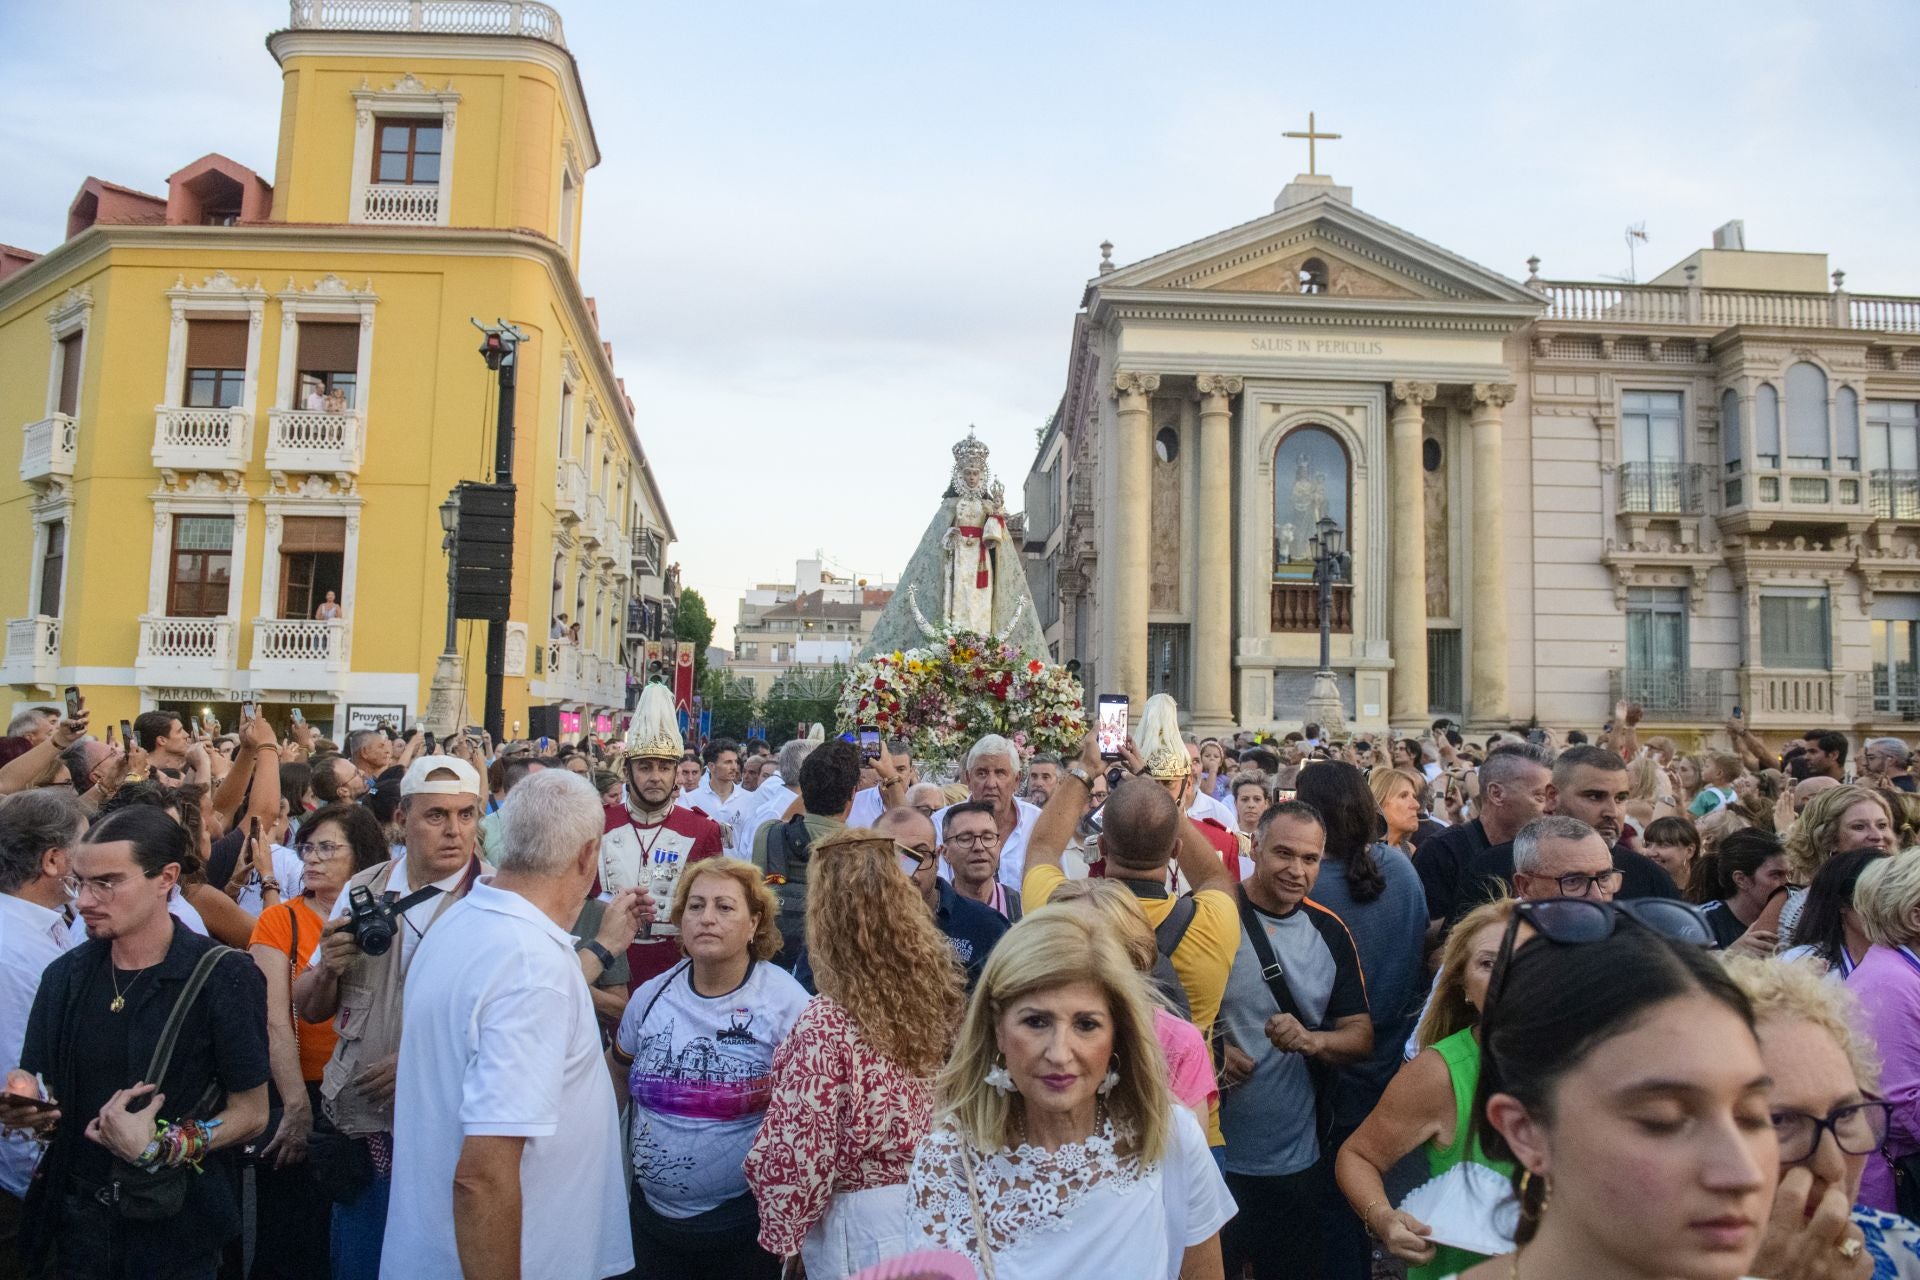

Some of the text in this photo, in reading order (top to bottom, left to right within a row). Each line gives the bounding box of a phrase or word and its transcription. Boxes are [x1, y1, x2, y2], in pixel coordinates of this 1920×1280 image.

[1251, 338, 1383, 355] SALUS IN PERICULIS
[158, 688, 216, 700] PARADOR
[289, 691, 316, 702] REY
[352, 711, 400, 722] Proyecto
